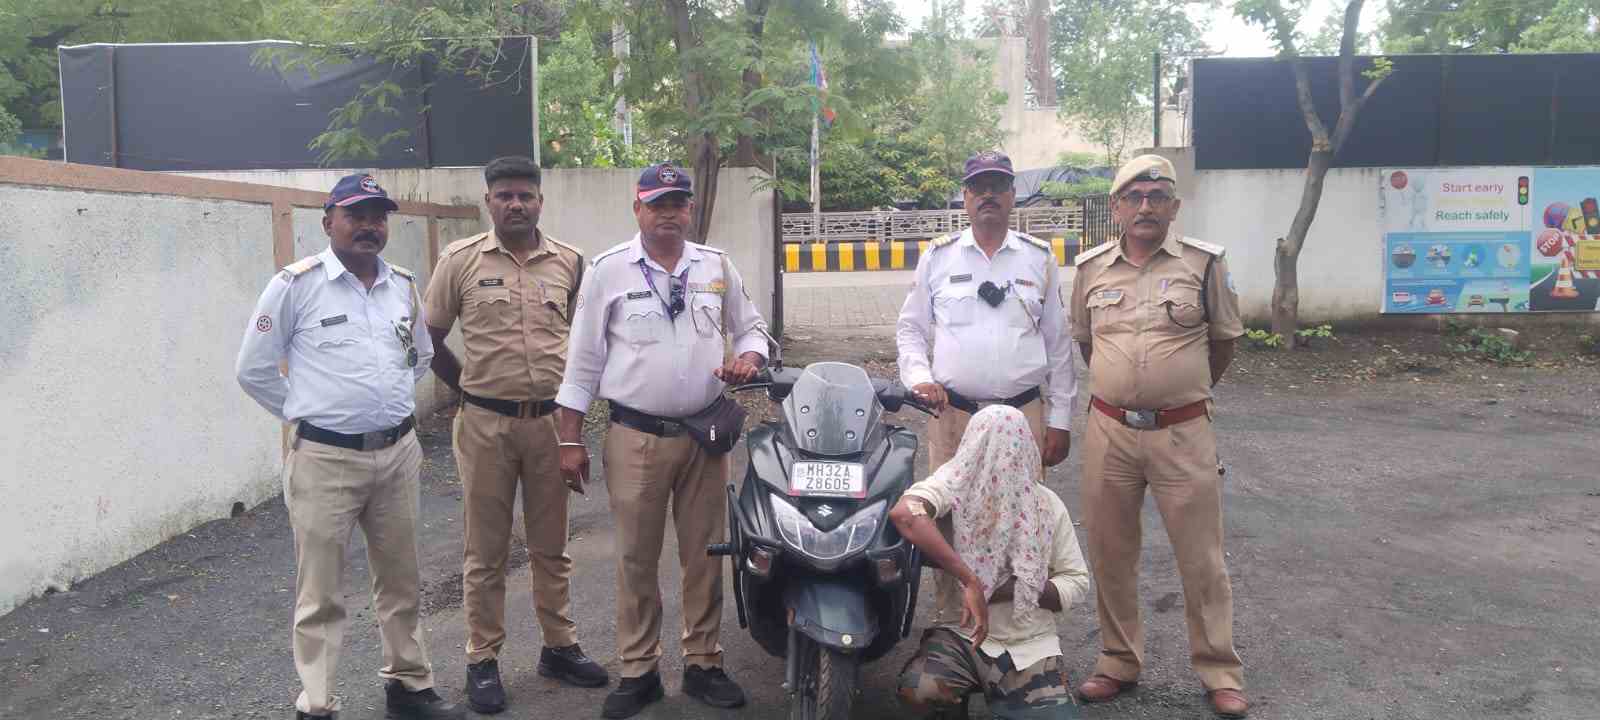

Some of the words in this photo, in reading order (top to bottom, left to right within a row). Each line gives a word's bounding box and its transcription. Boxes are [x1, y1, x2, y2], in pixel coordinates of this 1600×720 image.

[1442, 183, 1472, 193] Start
[1475, 183, 1504, 195] early
[1435, 209, 1472, 221] Reach
[1475, 208, 1510, 222] safely
[1540, 231, 1561, 253] STOP
[807, 463, 850, 477] MH32A
[806, 477, 850, 490] Z8605
